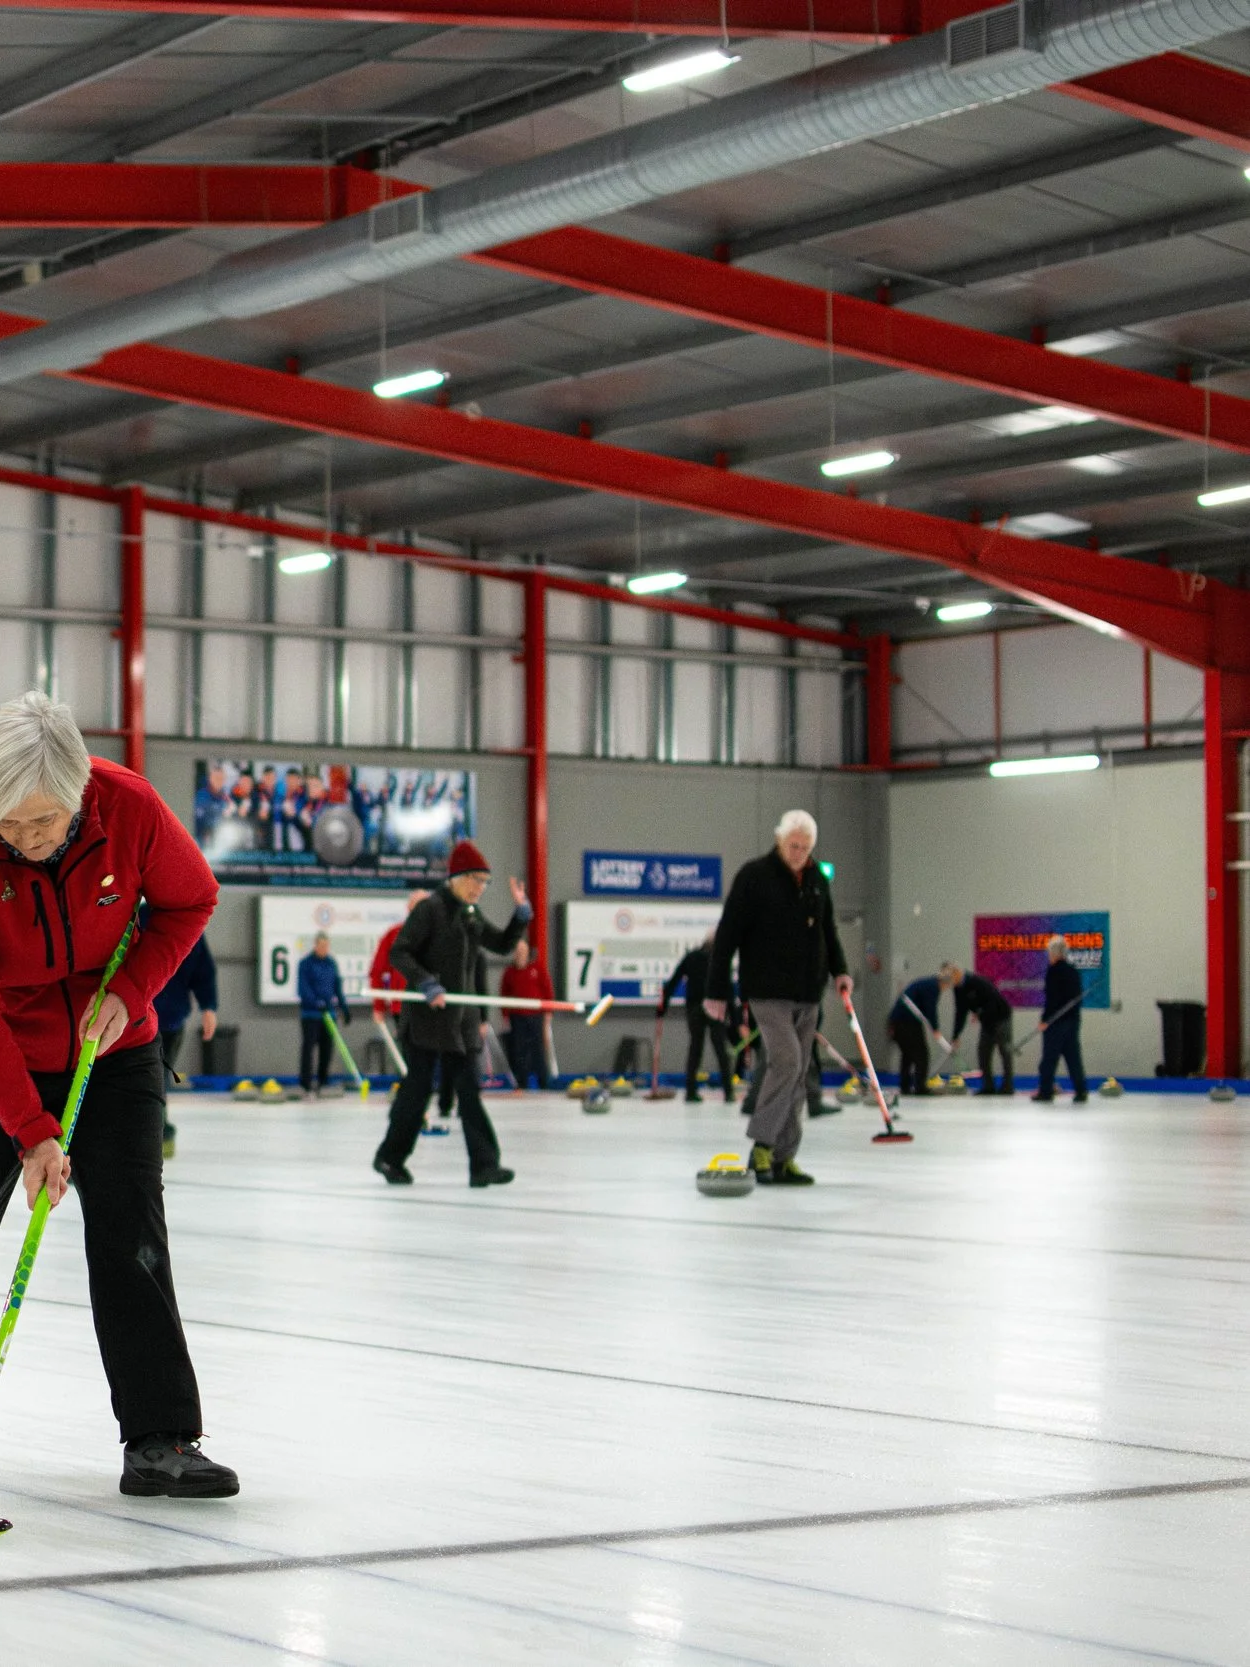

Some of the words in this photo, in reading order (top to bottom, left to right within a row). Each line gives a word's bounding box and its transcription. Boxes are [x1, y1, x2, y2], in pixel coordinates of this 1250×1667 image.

[979, 933, 1050, 951] SPECIALIZE
[271, 945, 290, 985] 6
[575, 949, 594, 989] 7
